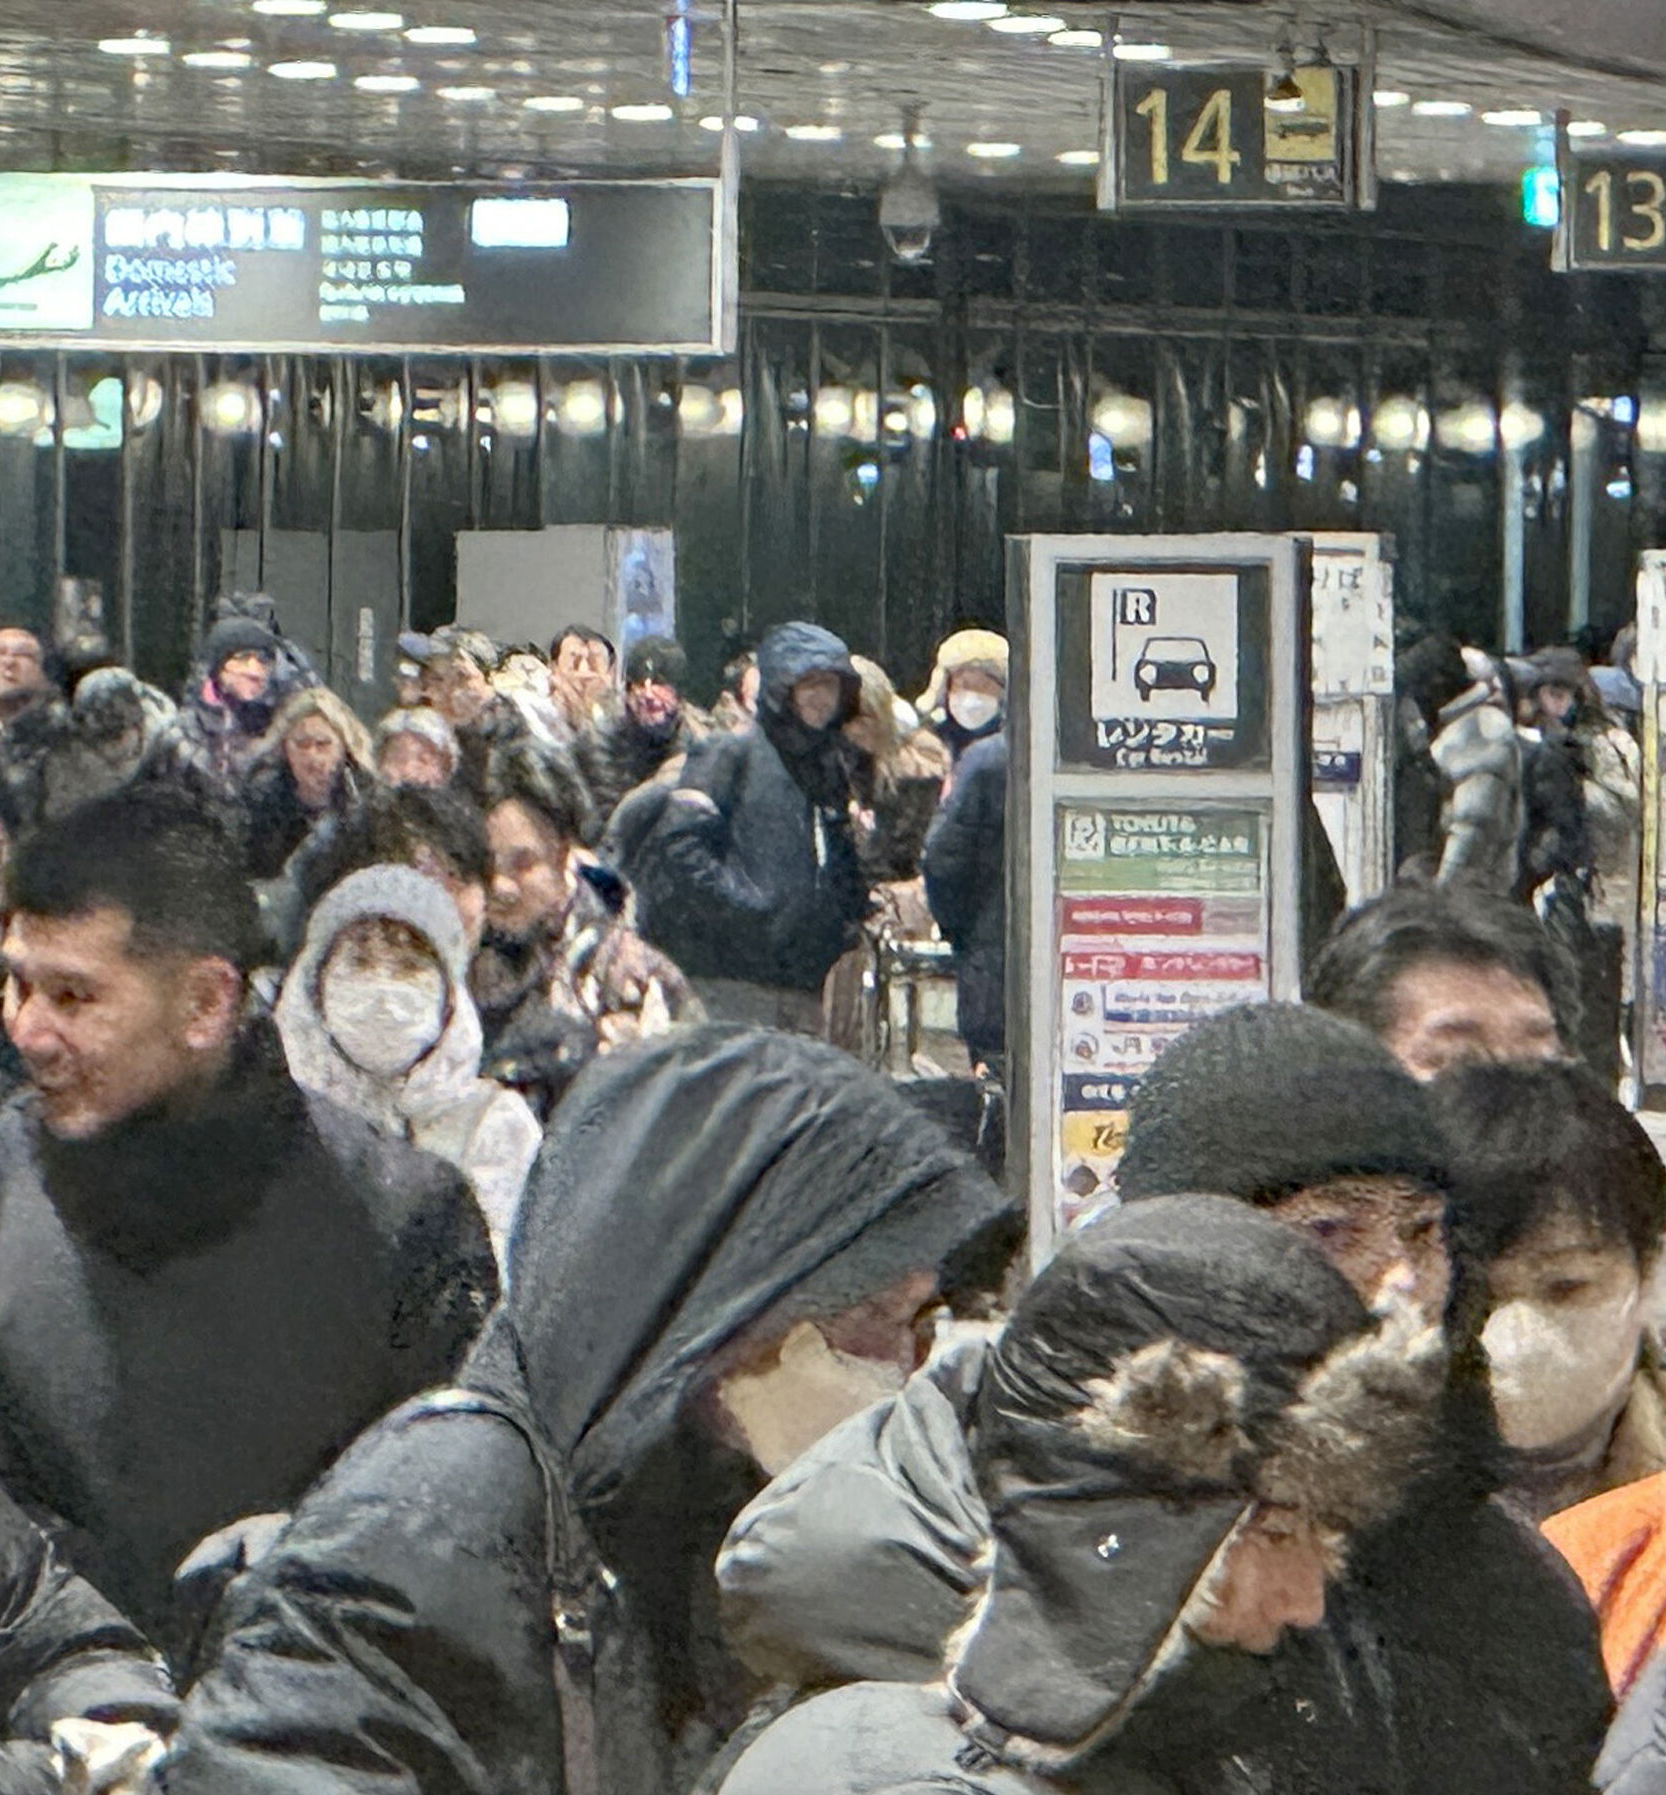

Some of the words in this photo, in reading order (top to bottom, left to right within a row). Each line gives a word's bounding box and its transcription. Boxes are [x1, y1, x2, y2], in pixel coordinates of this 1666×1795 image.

[1136, 89, 1241, 184] 14
[1585, 170, 1666, 250] 13
[1125, 591, 1152, 623] R
